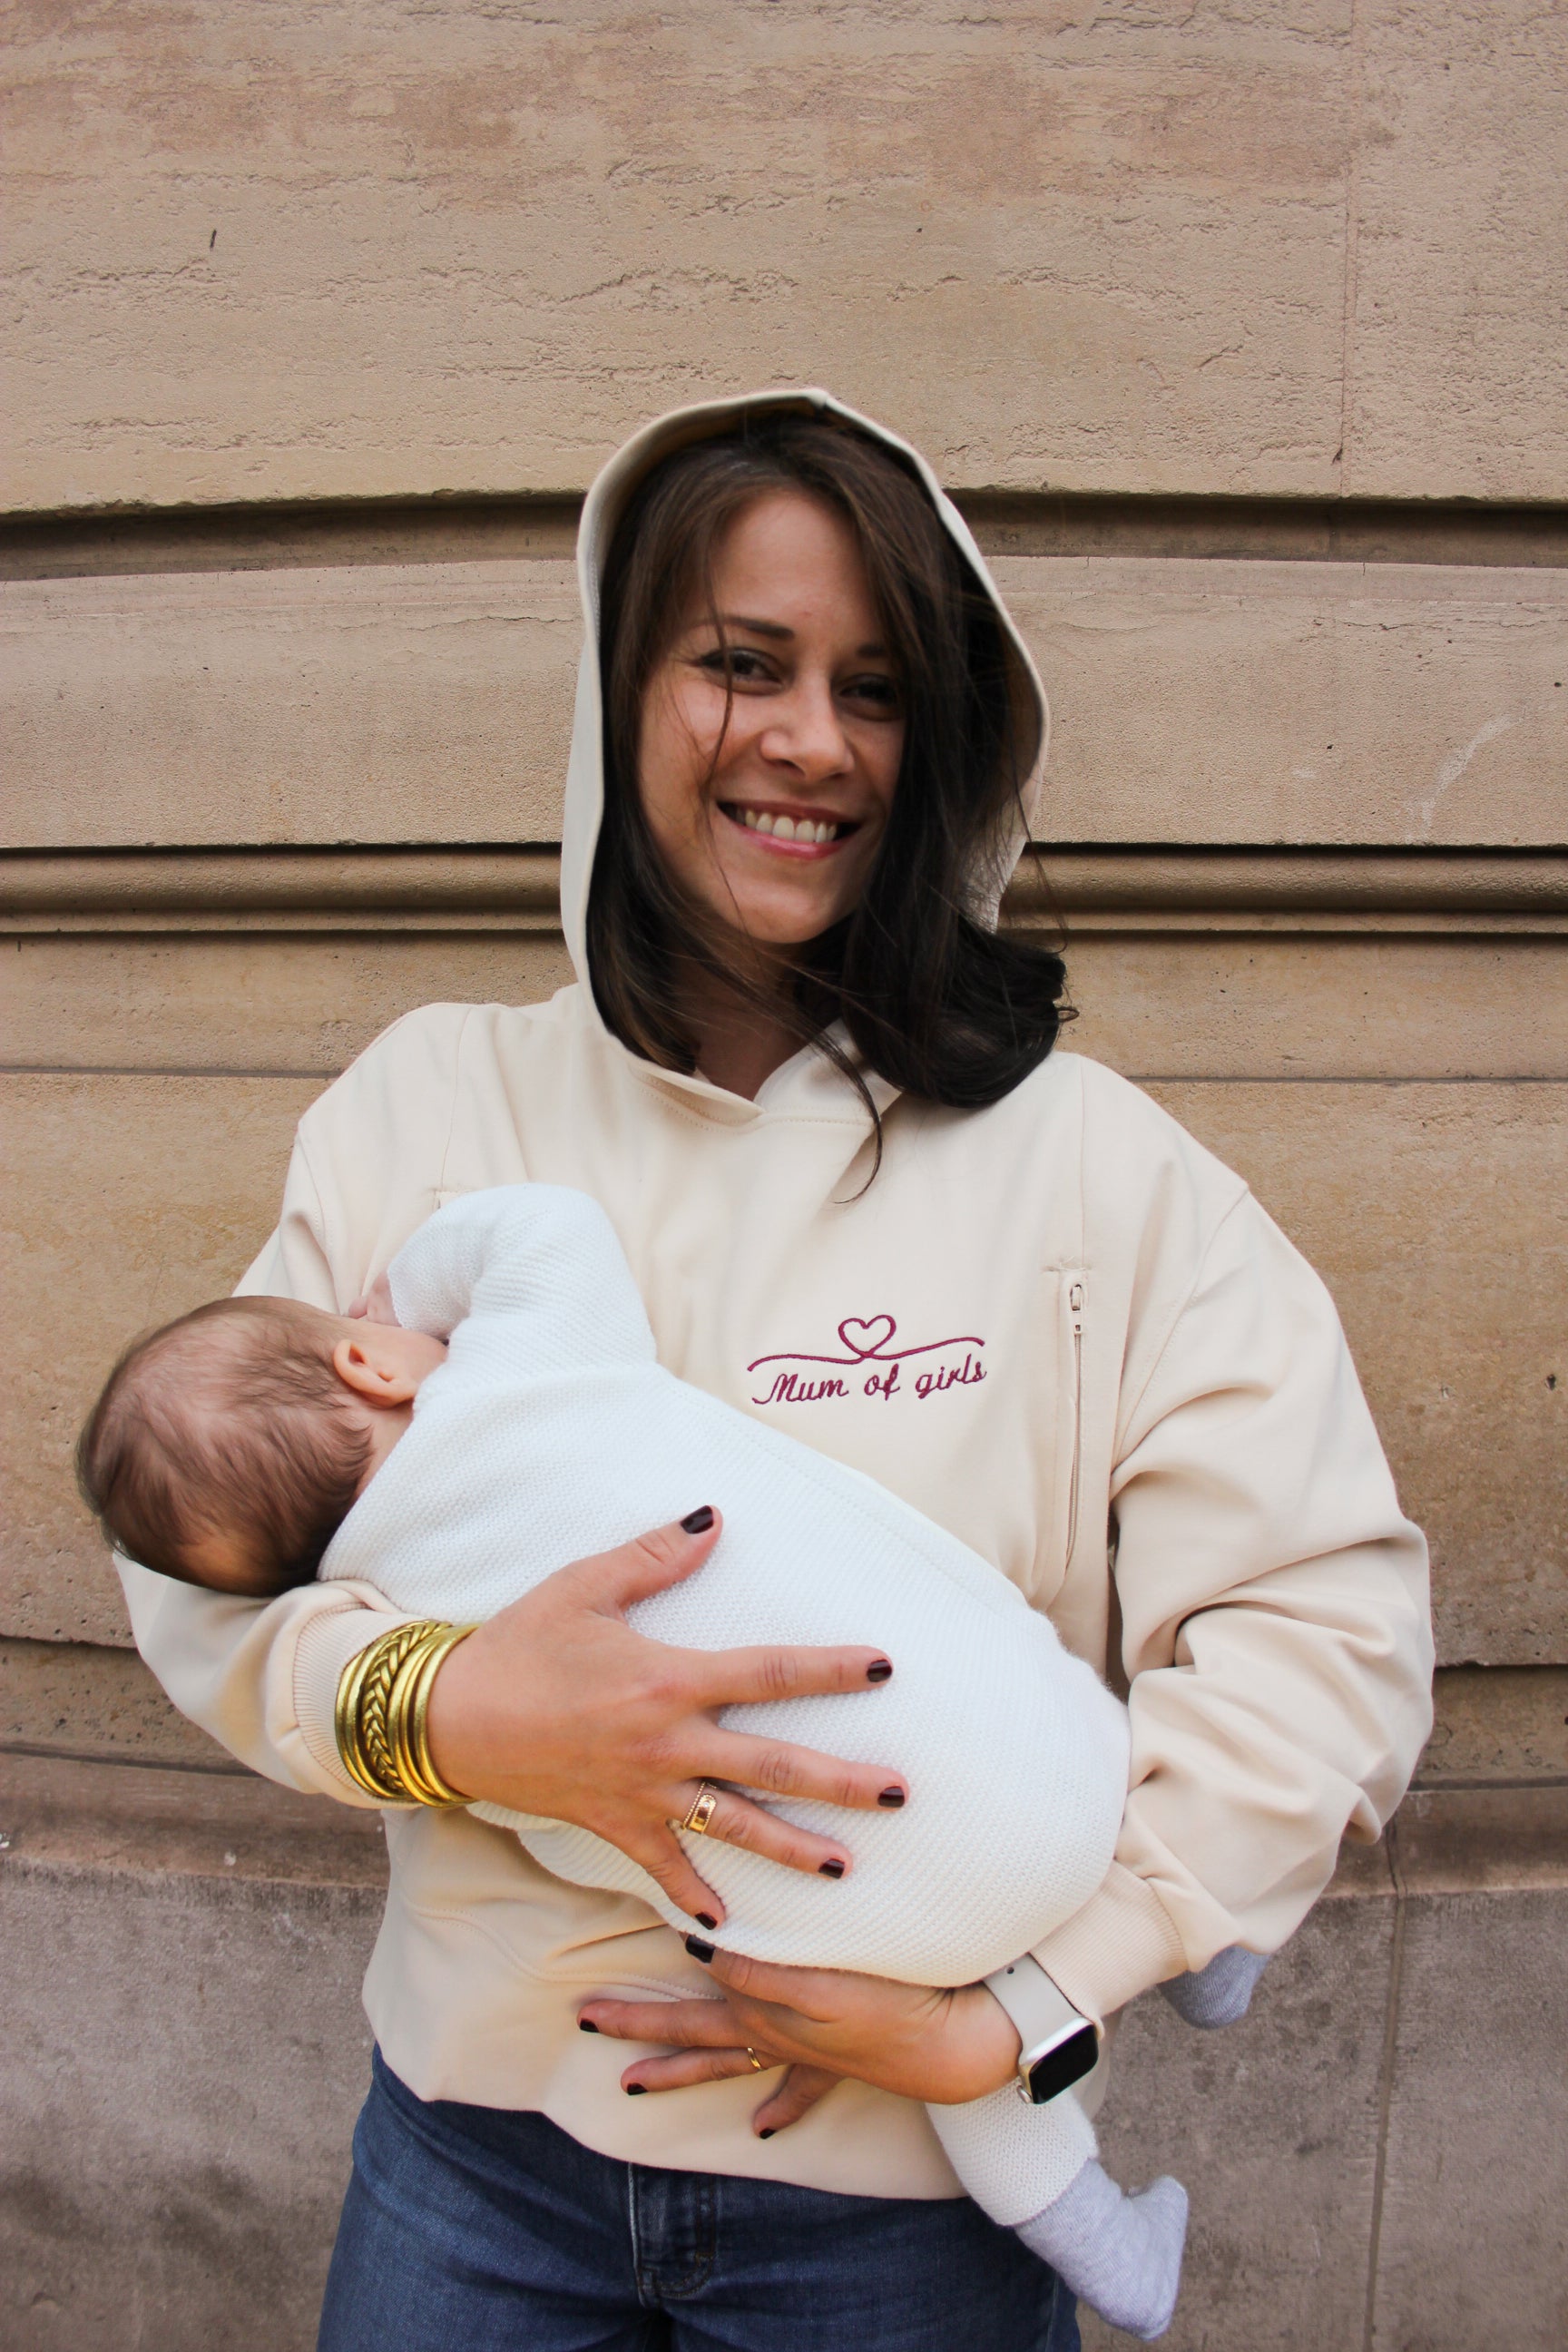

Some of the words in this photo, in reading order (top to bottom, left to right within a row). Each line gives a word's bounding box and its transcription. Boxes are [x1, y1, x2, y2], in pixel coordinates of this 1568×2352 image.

[752, 1373, 848, 1405] Mum
[864, 1363, 900, 1401] of
[915, 1353, 987, 1399] girls
